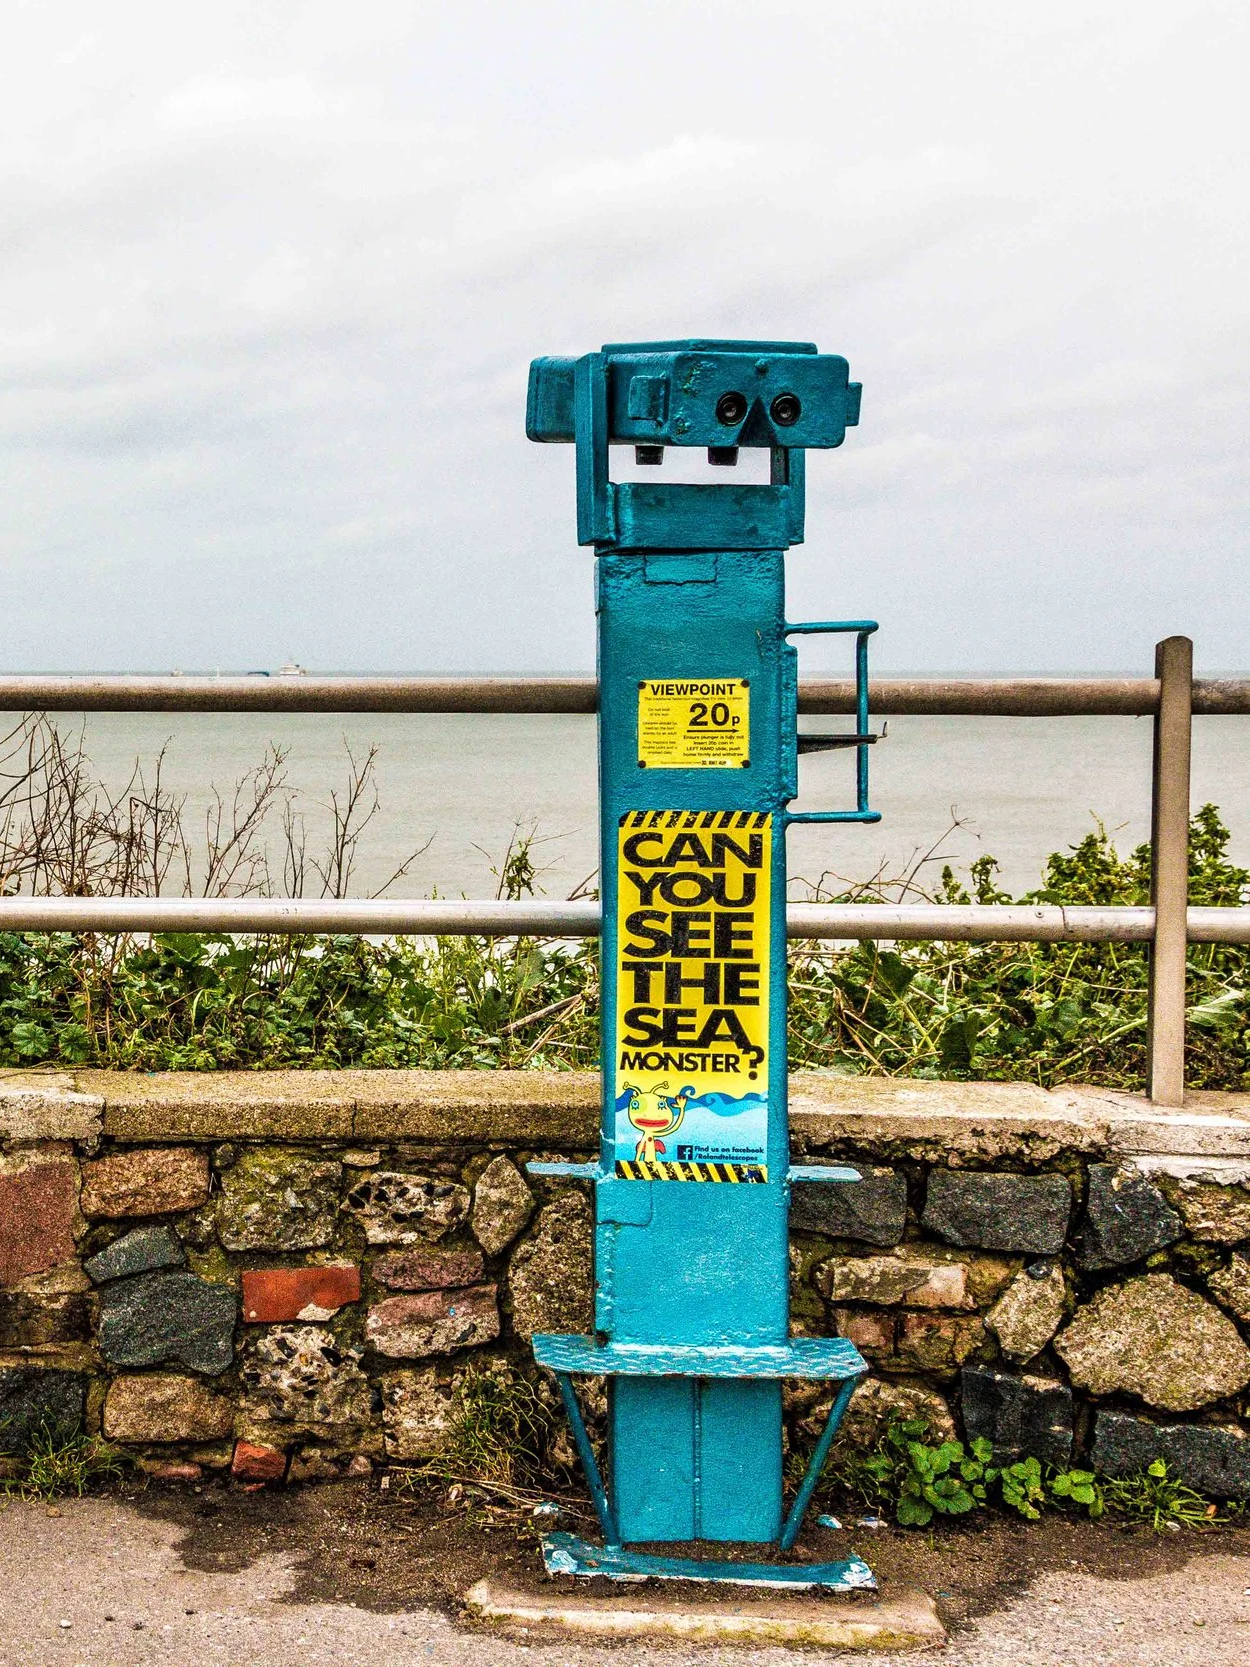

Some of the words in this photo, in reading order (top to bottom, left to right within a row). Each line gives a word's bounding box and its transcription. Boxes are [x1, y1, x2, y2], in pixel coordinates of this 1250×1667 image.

[650, 684, 736, 696] VIEWPOINT
[622, 832, 763, 869] CAN
[623, 871, 758, 908] YOU
[622, 910, 756, 959] SEE
[622, 961, 761, 1006] THE
[621, 1008, 751, 1050] SEA
[732, 1146, 764, 1154] facebook
